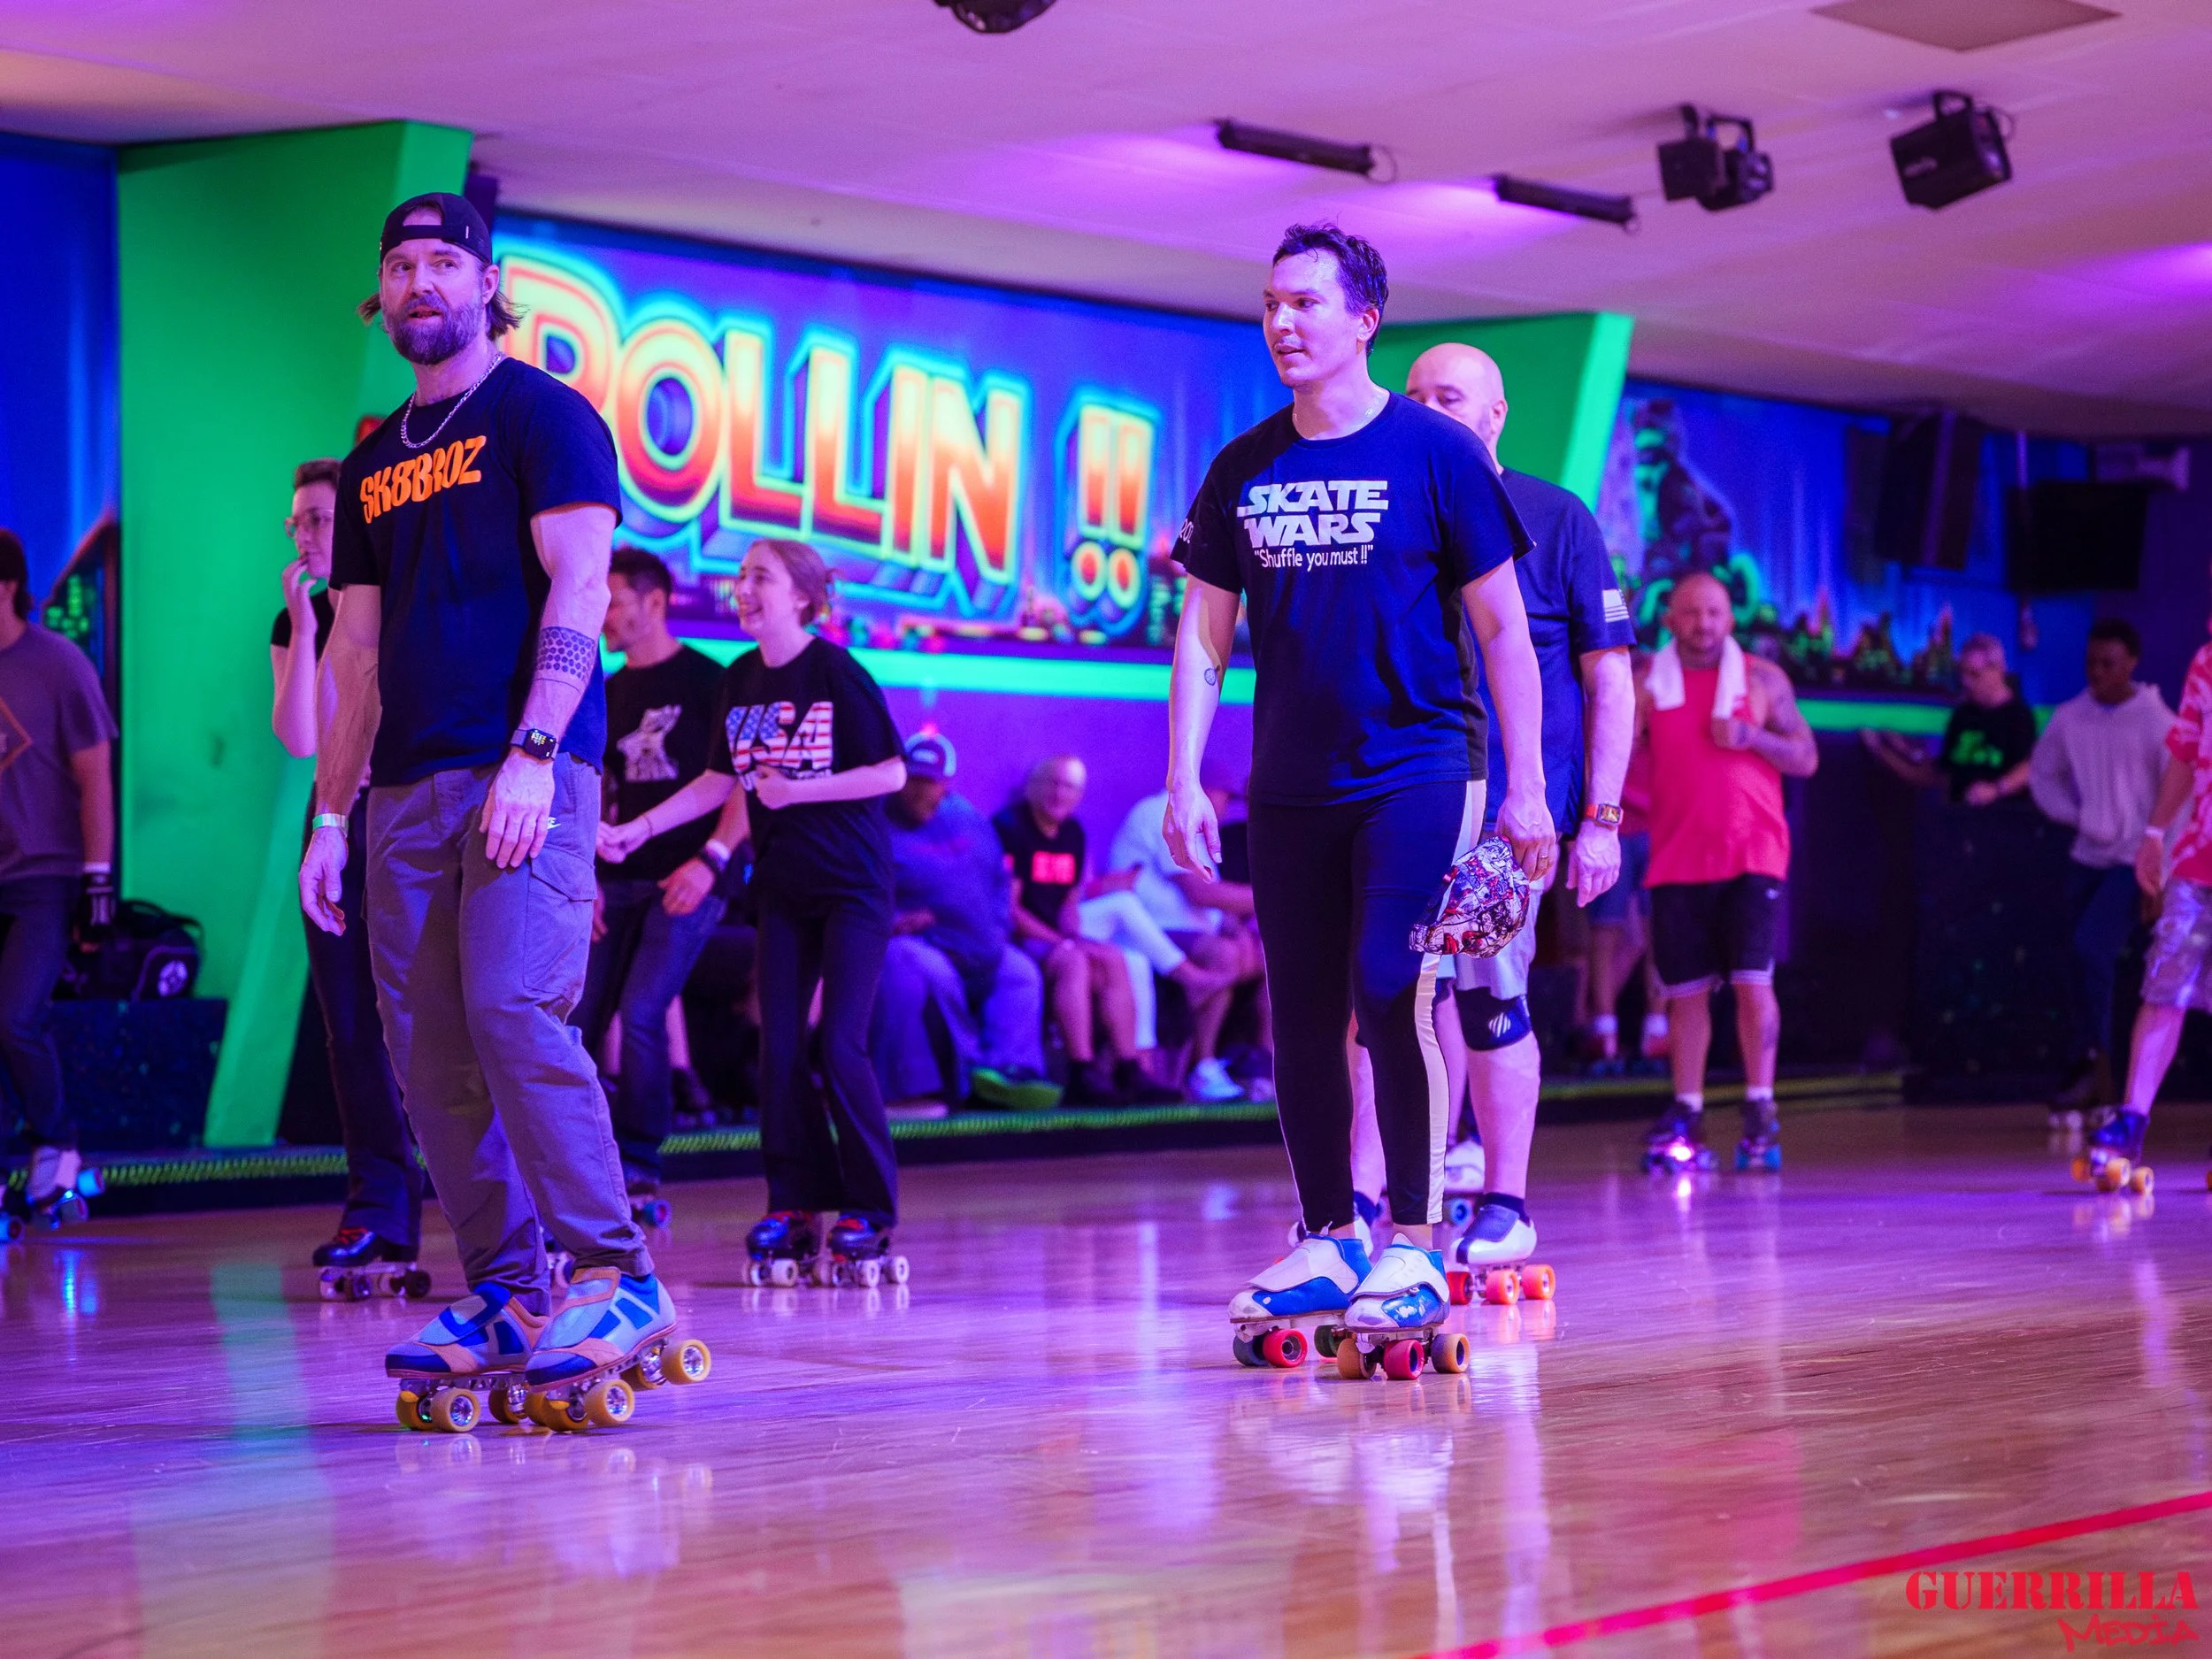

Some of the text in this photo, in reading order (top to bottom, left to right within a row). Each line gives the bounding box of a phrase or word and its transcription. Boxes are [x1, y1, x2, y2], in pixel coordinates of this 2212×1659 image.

[360, 435, 487, 524] SK8BROZ
[1237, 480, 1389, 517] SKATE
[1244, 512, 1381, 549] WARS
[1306, 551, 1329, 572] you
[1330, 549, 1358, 566] must
[726, 701, 833, 773] USA
